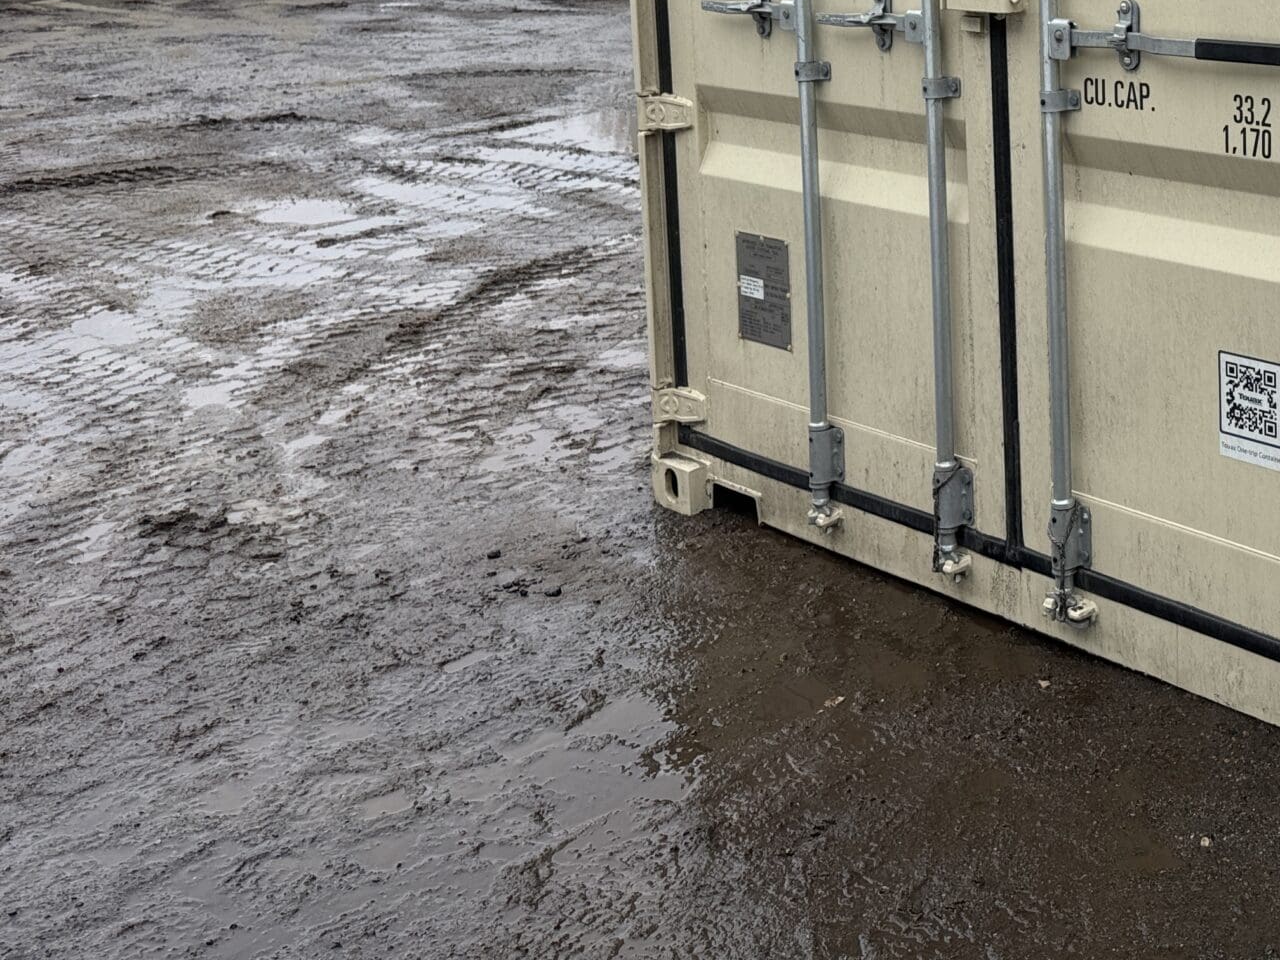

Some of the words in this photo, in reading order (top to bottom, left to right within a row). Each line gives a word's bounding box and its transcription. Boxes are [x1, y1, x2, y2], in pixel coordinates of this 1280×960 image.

[1084, 77, 1156, 112] CU.CAP.
[1233, 95, 1272, 128] 33.2
[1222, 124, 1272, 159] 1,170
